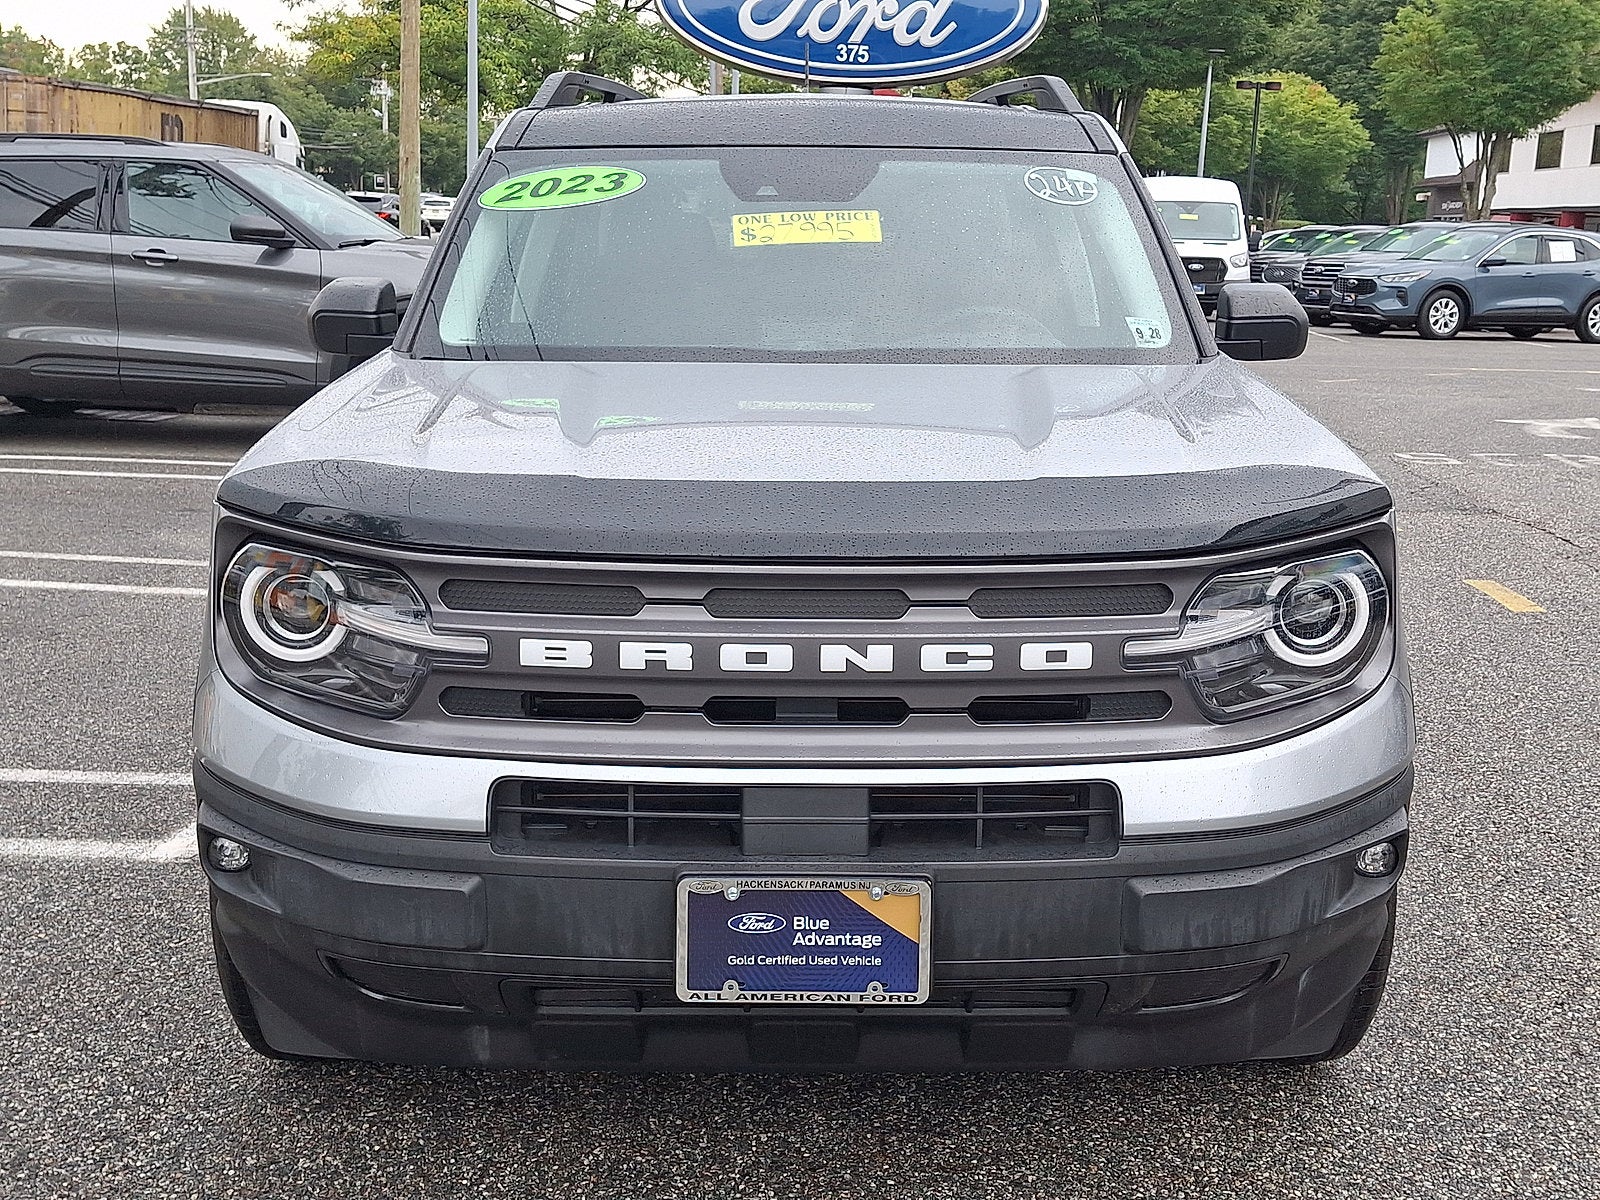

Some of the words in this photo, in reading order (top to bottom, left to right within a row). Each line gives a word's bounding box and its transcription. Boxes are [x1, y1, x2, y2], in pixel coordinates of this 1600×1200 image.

[835, 43, 870, 63] 375
[494, 172, 629, 205] 2023
[738, 214, 772, 225] ONE
[780, 212, 816, 222] LOW
[825, 211, 875, 221] PRICE
[1135, 327, 1144, 339] 9
[1148, 327, 1162, 340] 28
[519, 638, 1093, 673] BRONCO
[736, 880, 856, 890] HACKENSACK/PARAMUS
[858, 881, 872, 890] NJ
[738, 915, 776, 930] Ford
[792, 916, 830, 931] Blue
[792, 932, 882, 949] Advantage
[727, 955, 755, 966] Gold
[757, 955, 806, 966] Certified
[808, 955, 838, 967] Used
[840, 956, 882, 967] Vehicle
[688, 992, 729, 1001] ALL
[735, 993, 851, 1003] AMERICAN
[859, 994, 918, 1003] FORD
